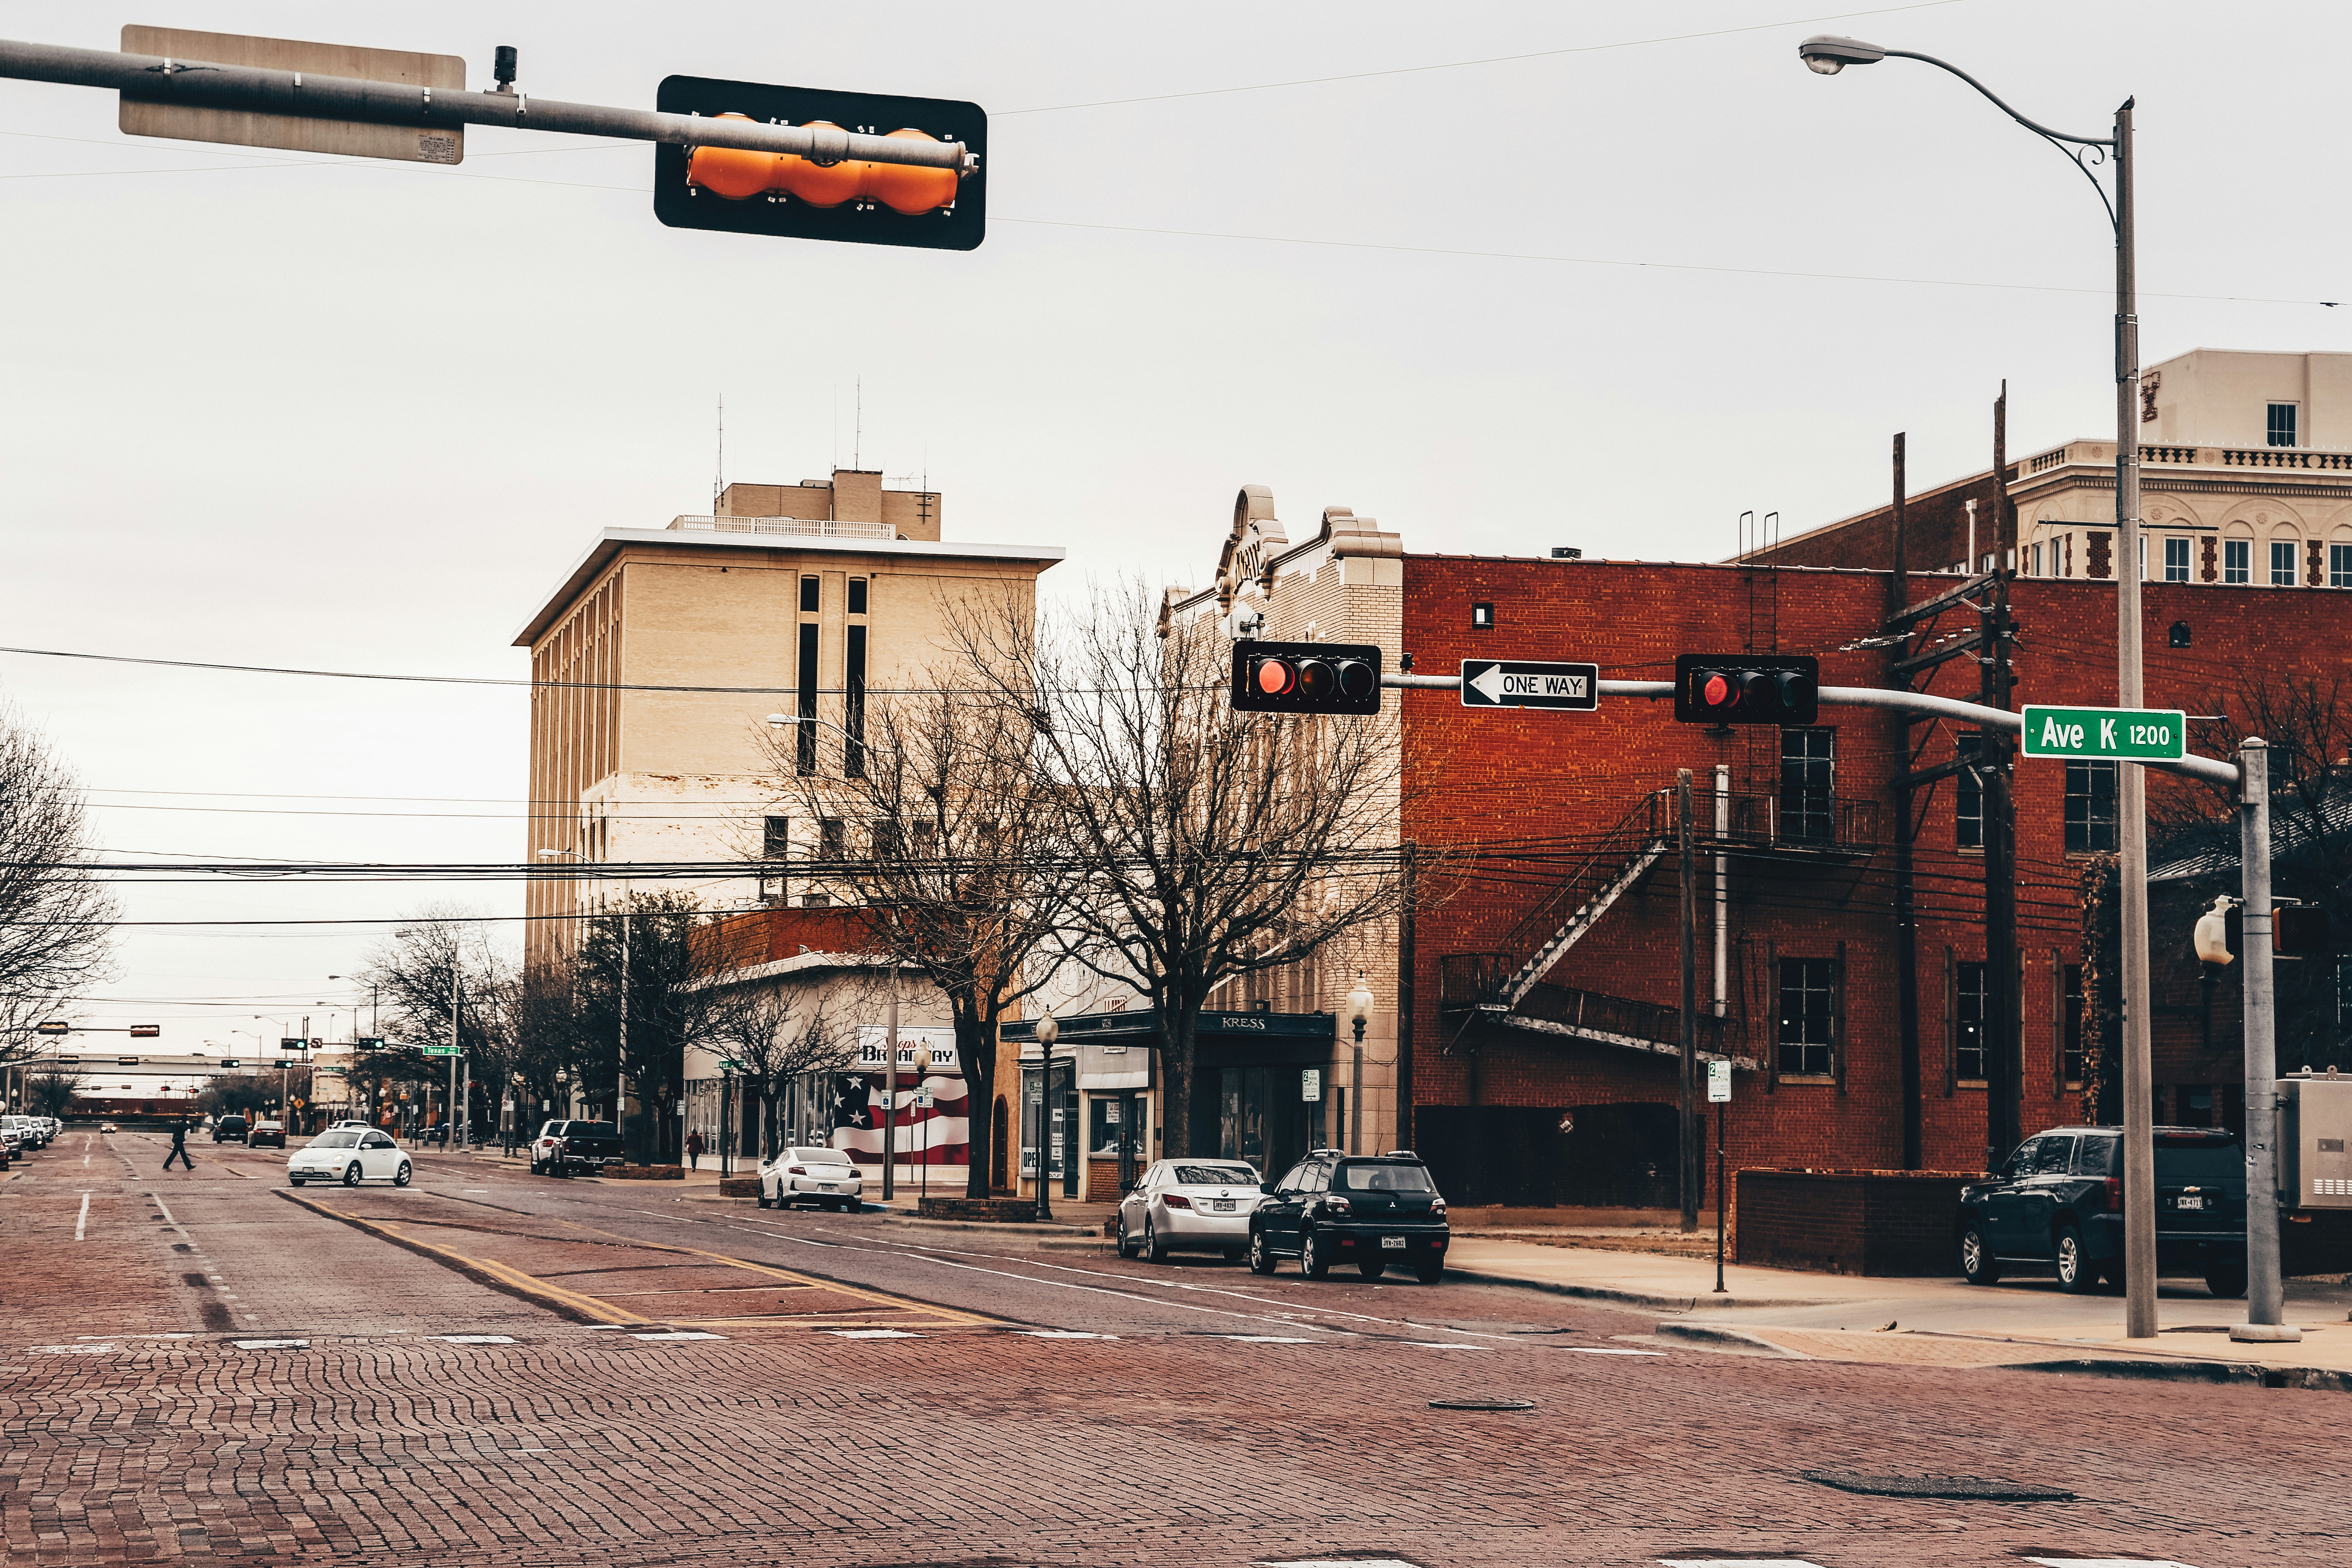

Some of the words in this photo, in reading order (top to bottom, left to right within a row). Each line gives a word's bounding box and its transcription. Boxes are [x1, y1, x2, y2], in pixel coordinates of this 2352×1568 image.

[1504, 676, 1538, 693] ONE
[1545, 677, 1582, 695] WAY
[2041, 717, 2084, 749] Ave
[2101, 718, 2117, 749] K
[2130, 725, 2170, 745] 1200
[1222, 1018, 1265, 1029] KRESS
[880, 1037, 917, 1052] Sops
[1710, 1064, 1715, 1075] 2
[1023, 1152, 1040, 1168] OPE
